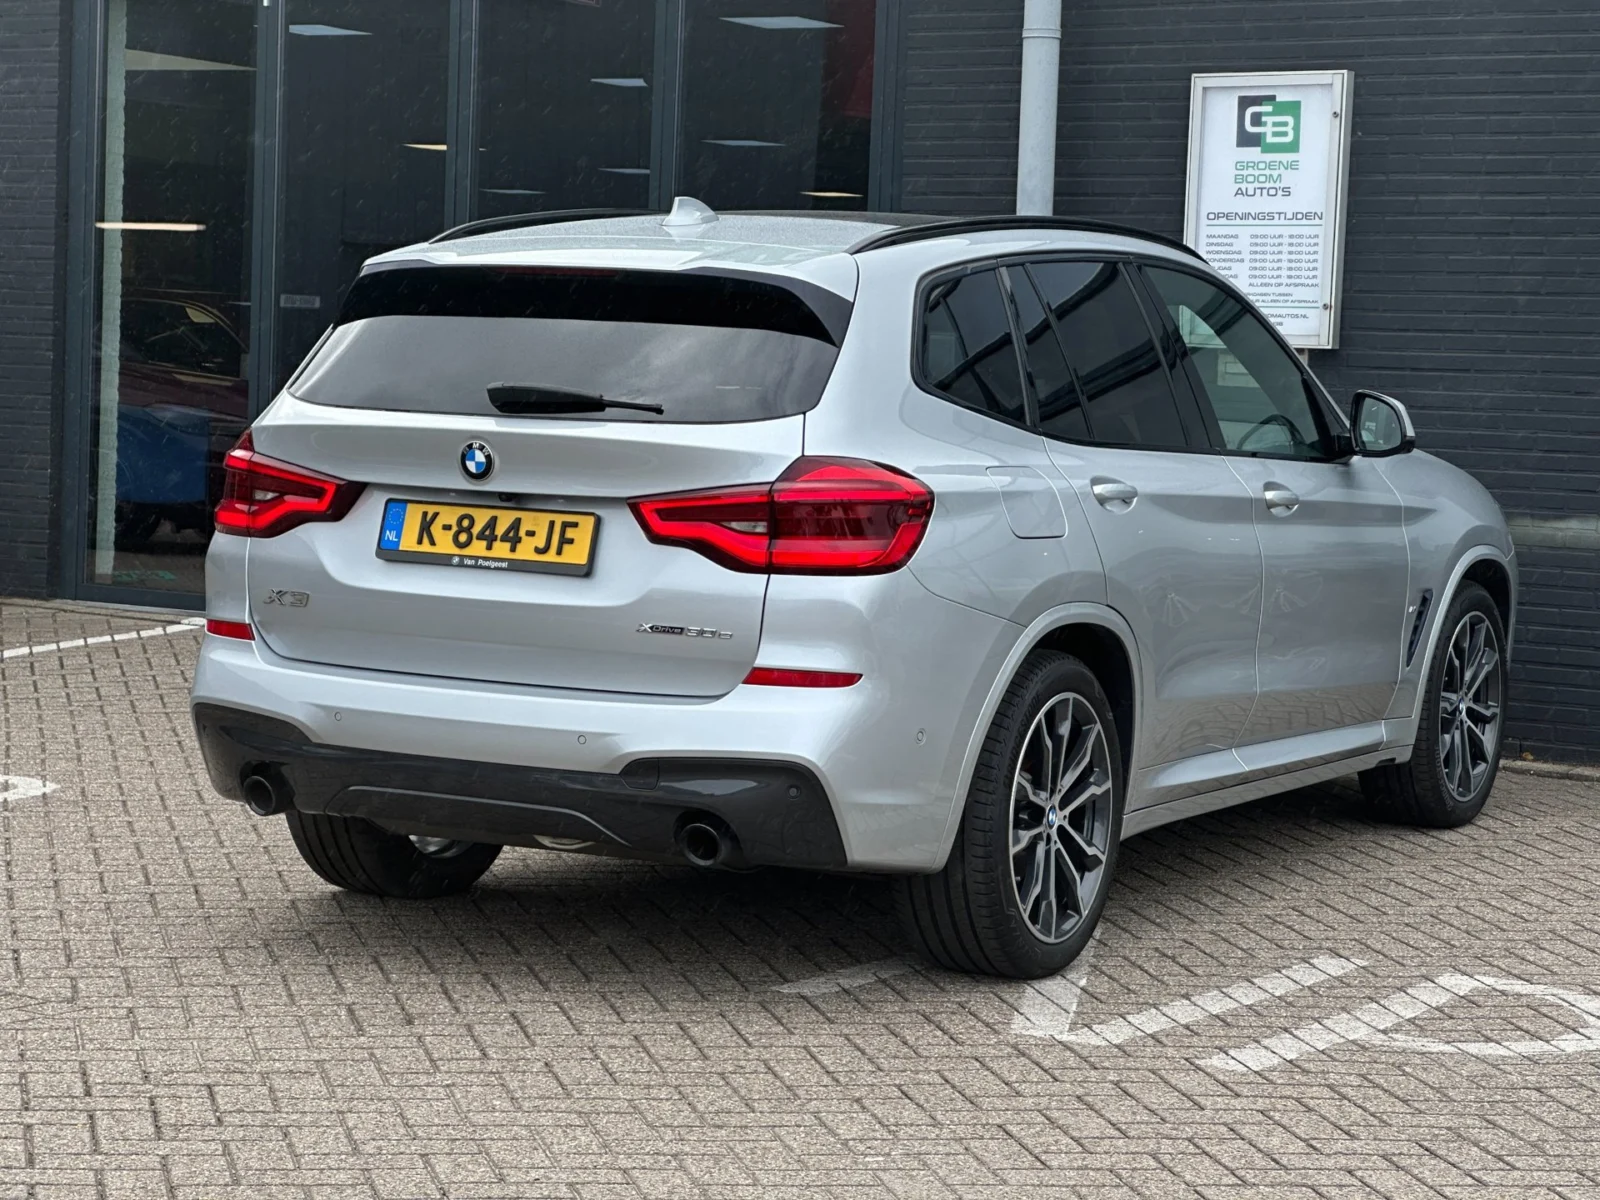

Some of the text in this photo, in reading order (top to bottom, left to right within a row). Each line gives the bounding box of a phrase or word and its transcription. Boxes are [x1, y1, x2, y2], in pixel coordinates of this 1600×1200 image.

[1235, 160, 1299, 170] GROENE
[1234, 174, 1282, 184] BOOM
[1234, 186, 1291, 197] AUTO'S
[1206, 211, 1323, 220] OPENINGSTIJDEN
[384, 530, 399, 542] NL
[416, 511, 579, 556] K-844-JF
[478, 559, 508, 568] Poelgeest
[262, 588, 310, 608] X3
